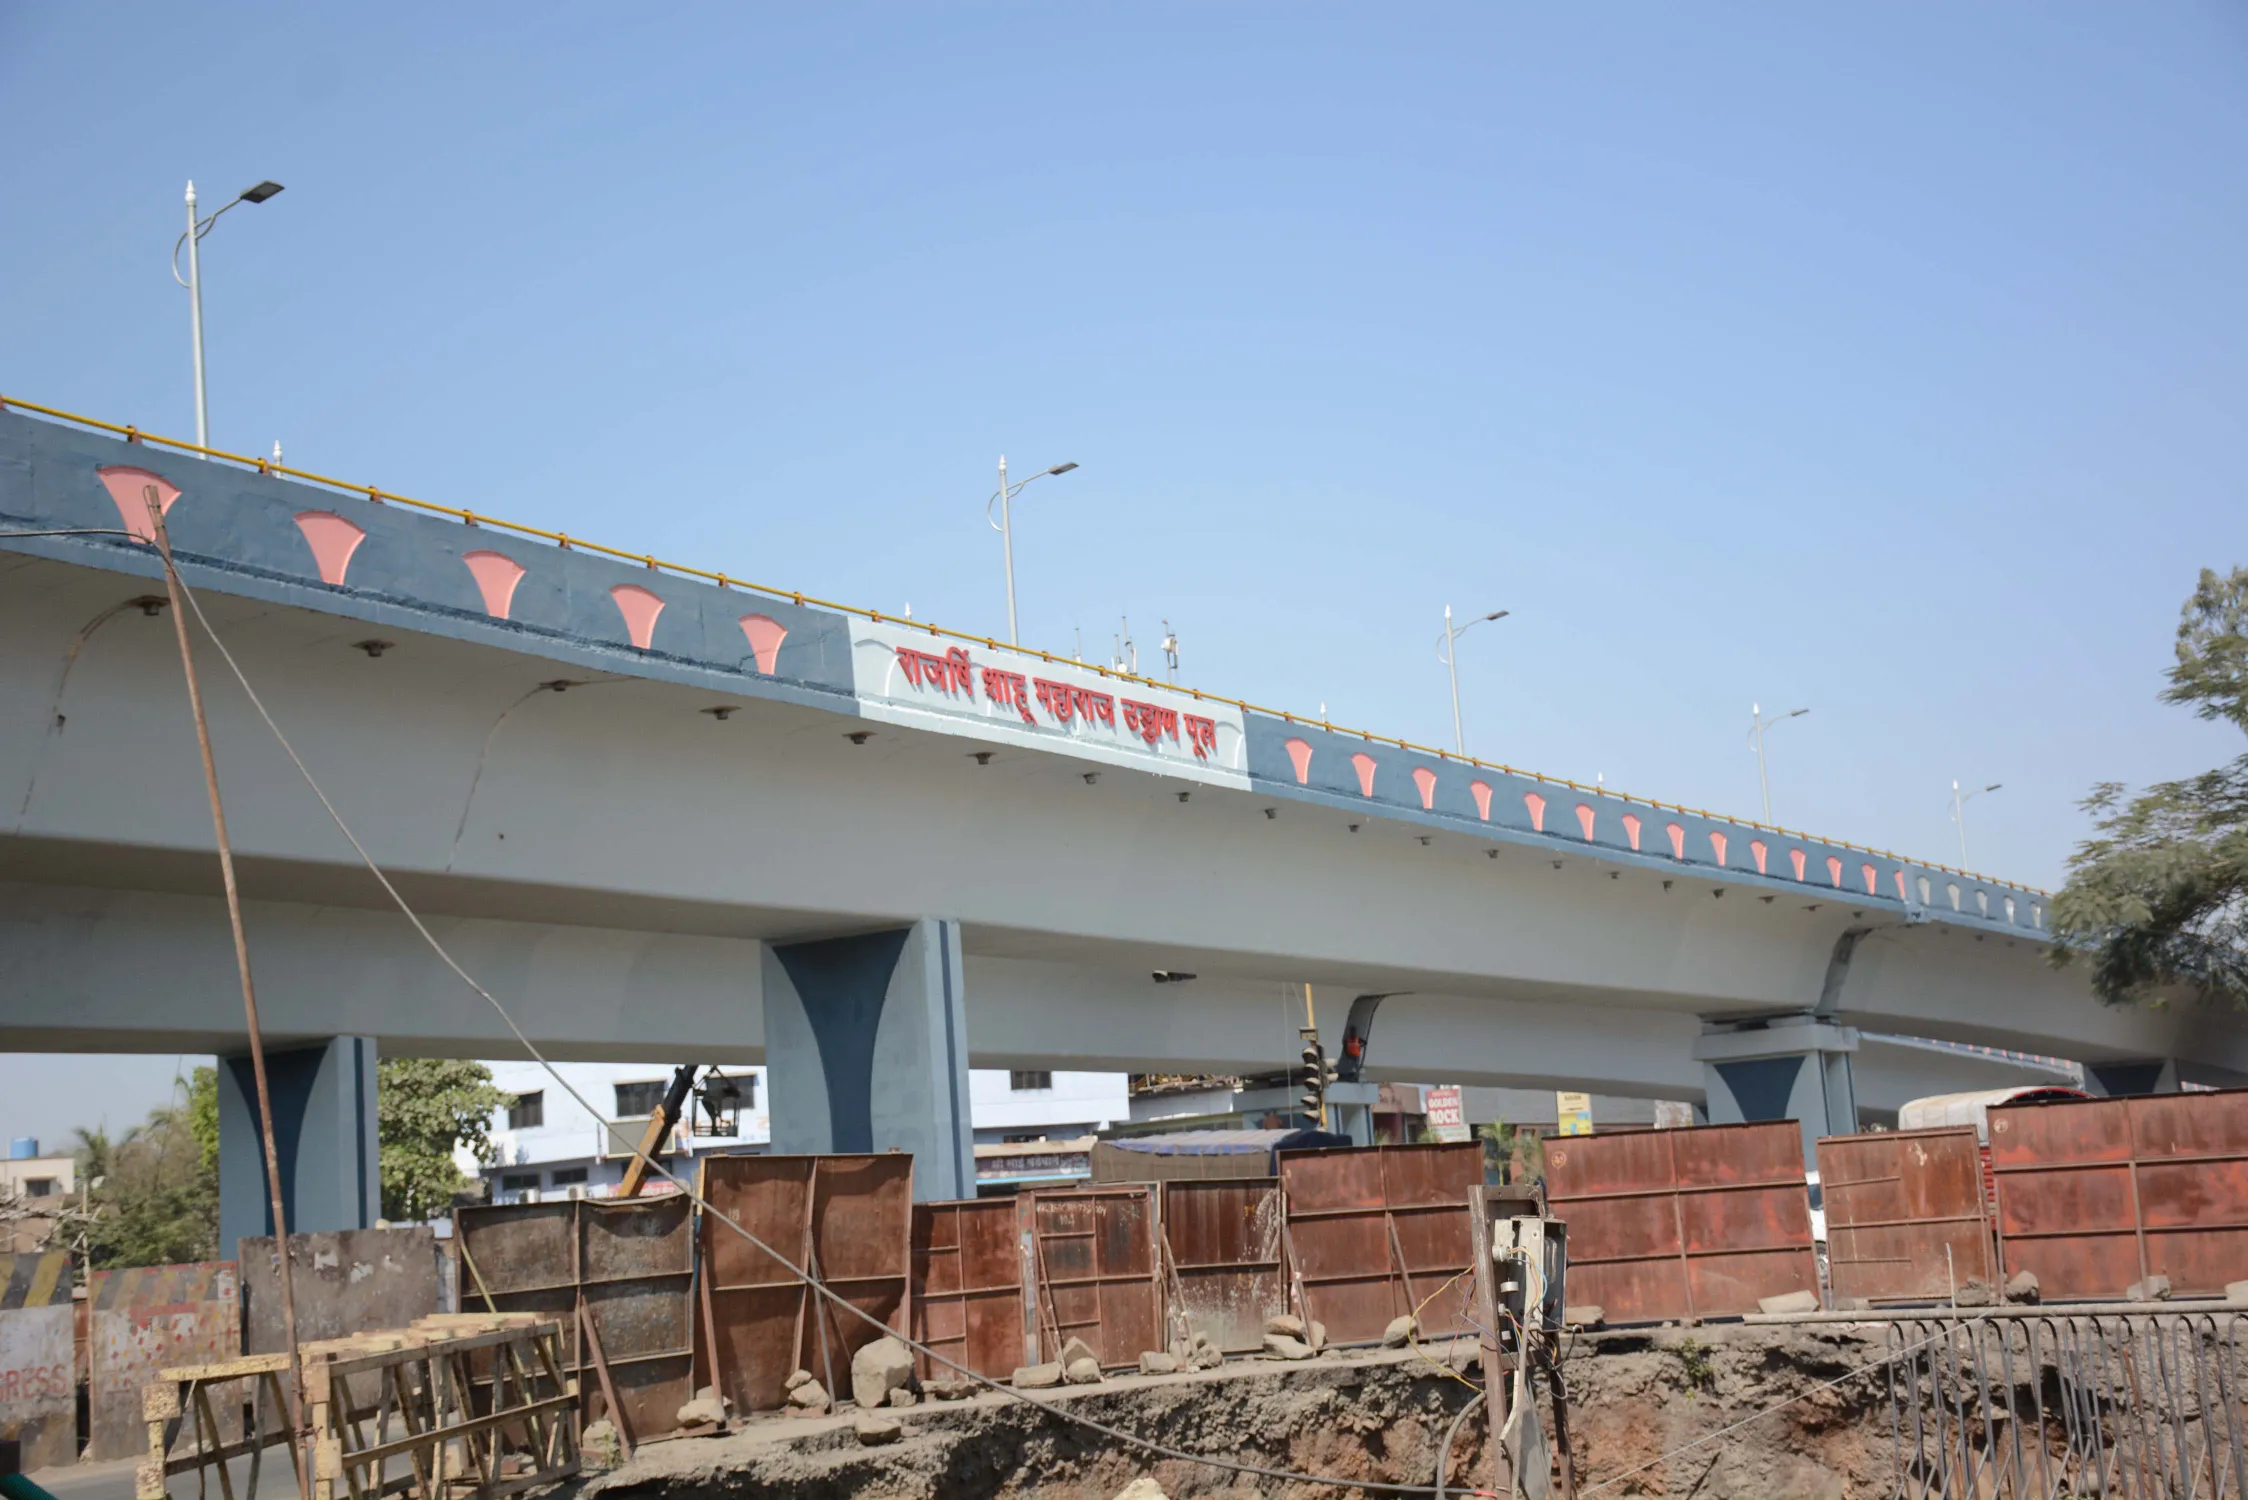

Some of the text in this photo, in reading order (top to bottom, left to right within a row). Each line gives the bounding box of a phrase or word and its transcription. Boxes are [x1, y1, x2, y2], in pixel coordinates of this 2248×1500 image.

[896, 646, 972, 697] राजर्षि
[1032, 677, 1115, 727] महाराज
[1182, 713, 1217, 760] पूल
[1428, 1097, 1459, 1109] GOLDEN
[1429, 1109, 1460, 1125] ROCK
[0, 1363, 68, 1402] RESS
